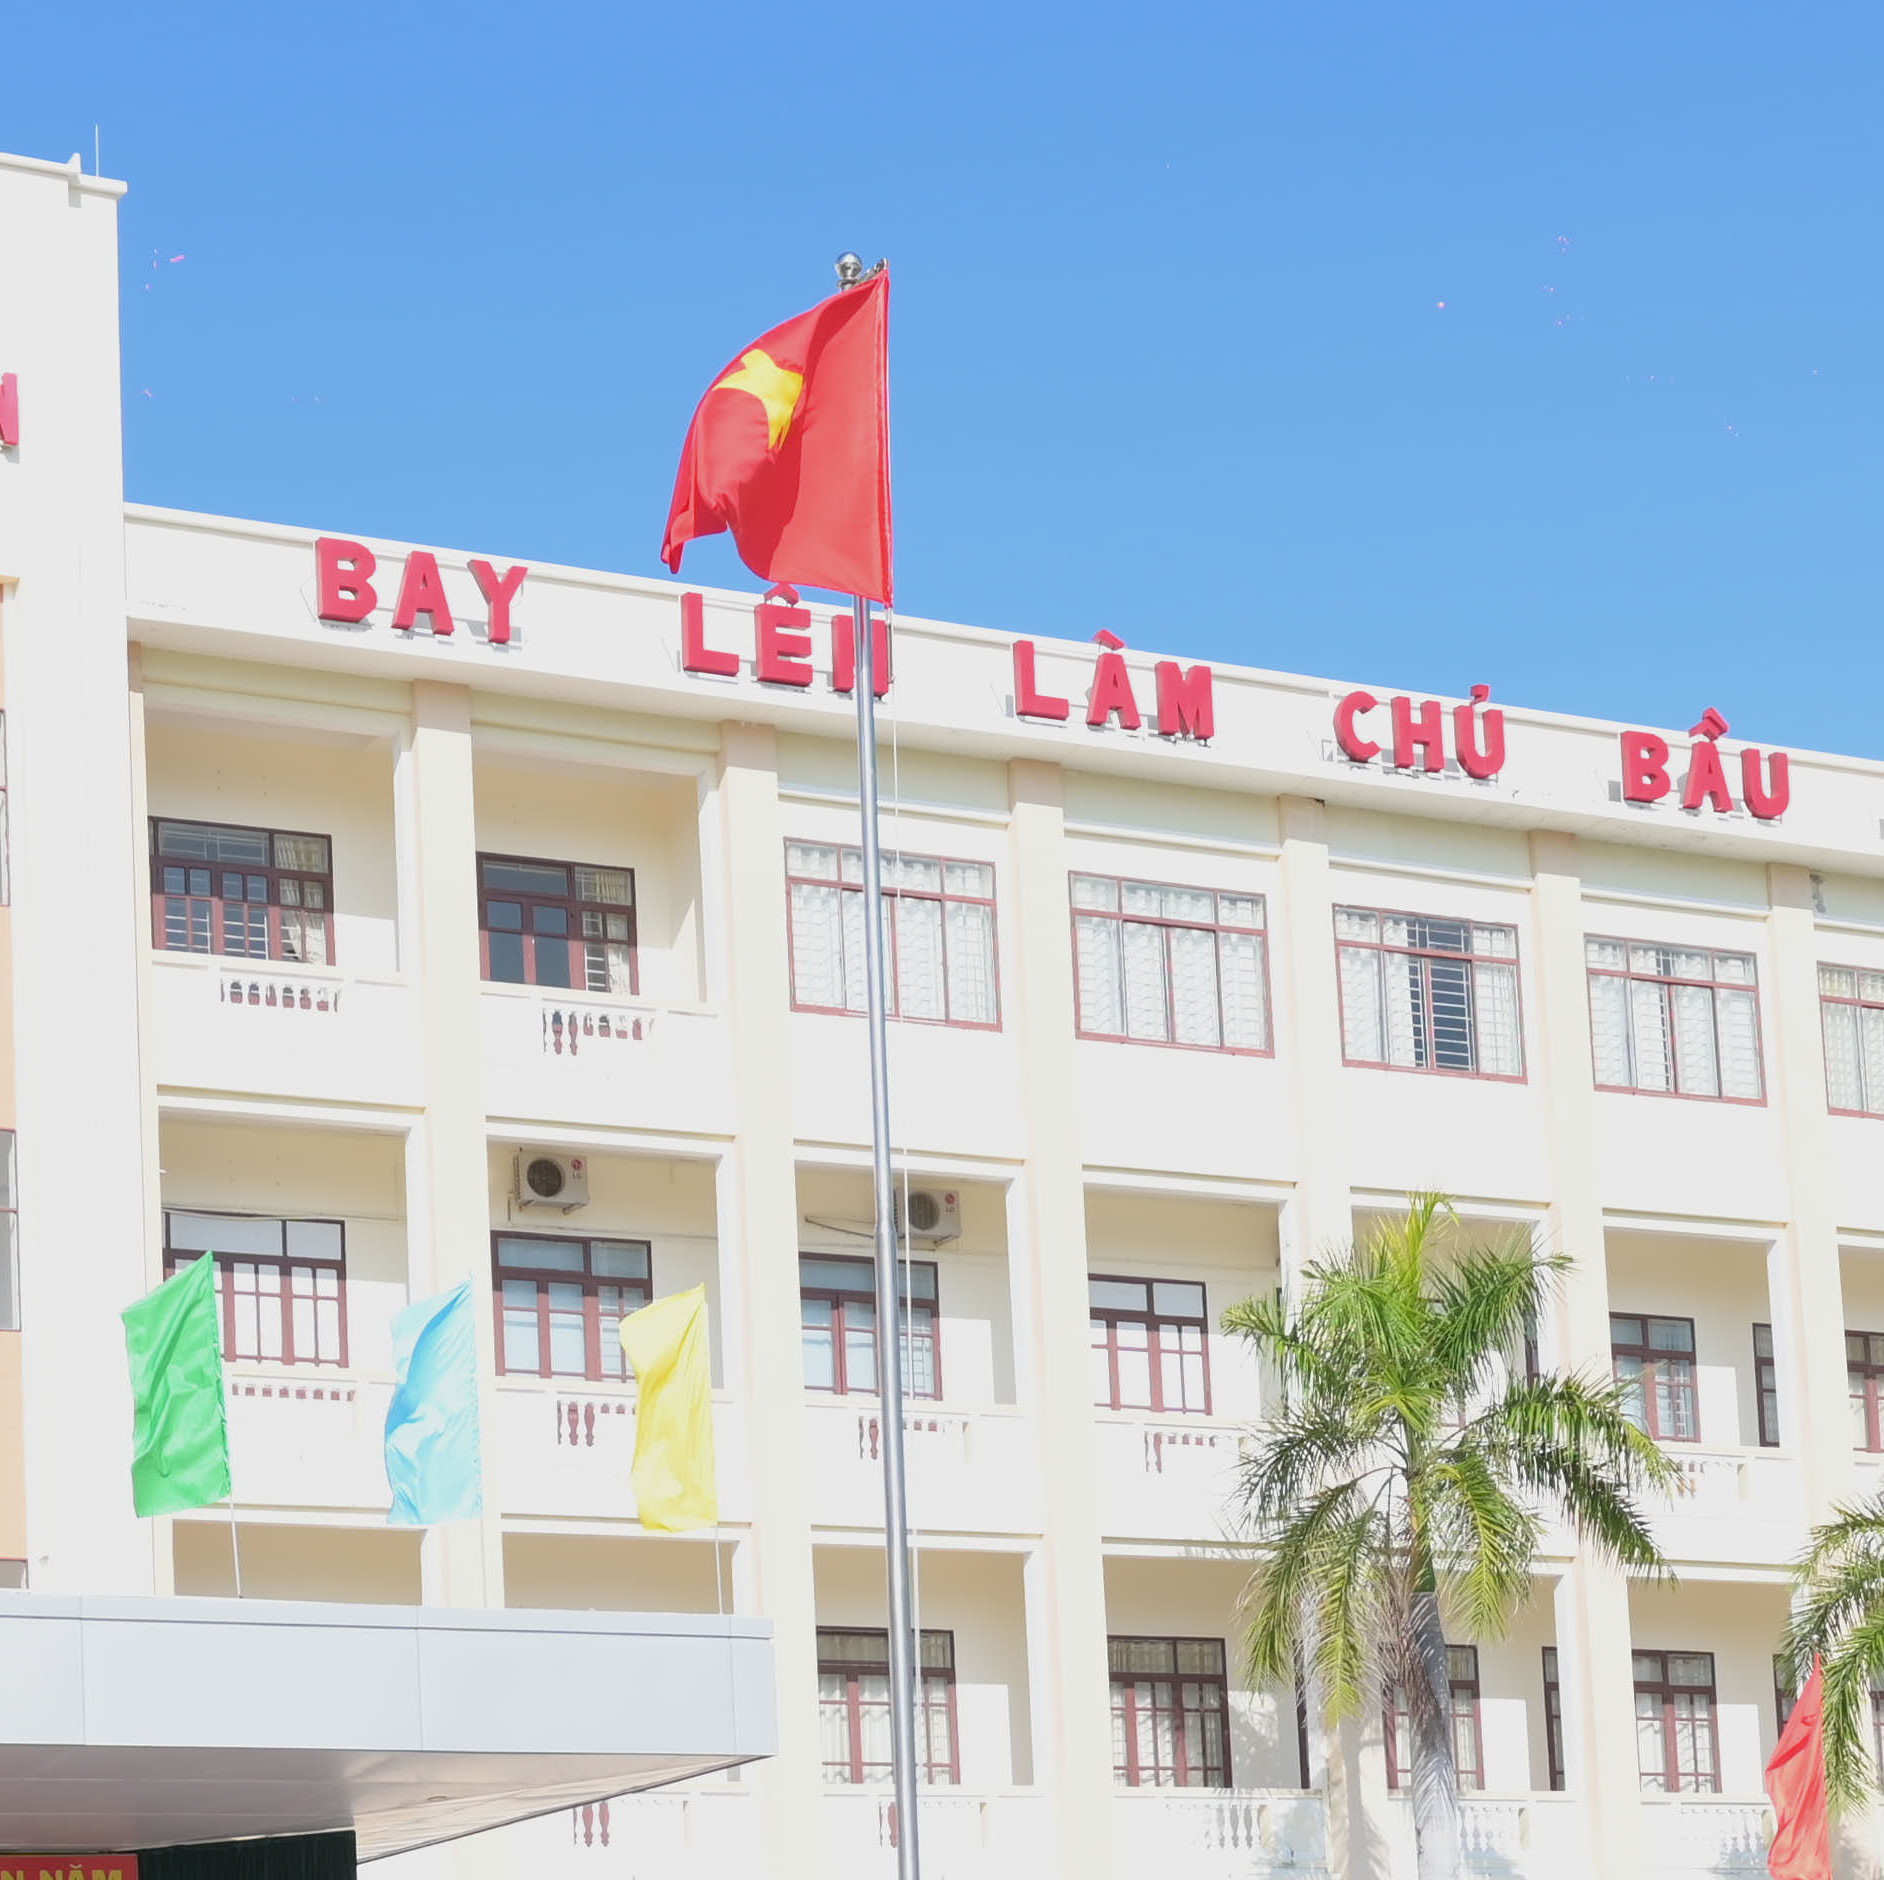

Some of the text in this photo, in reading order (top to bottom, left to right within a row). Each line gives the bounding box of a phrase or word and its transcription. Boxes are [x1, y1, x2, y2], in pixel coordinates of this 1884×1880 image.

[315, 535, 528, 645] BAY
[1012, 628, 1215, 742] LÀM
[1333, 684, 1505, 780] CHỦ
[1620, 706, 1789, 820] BẦU
